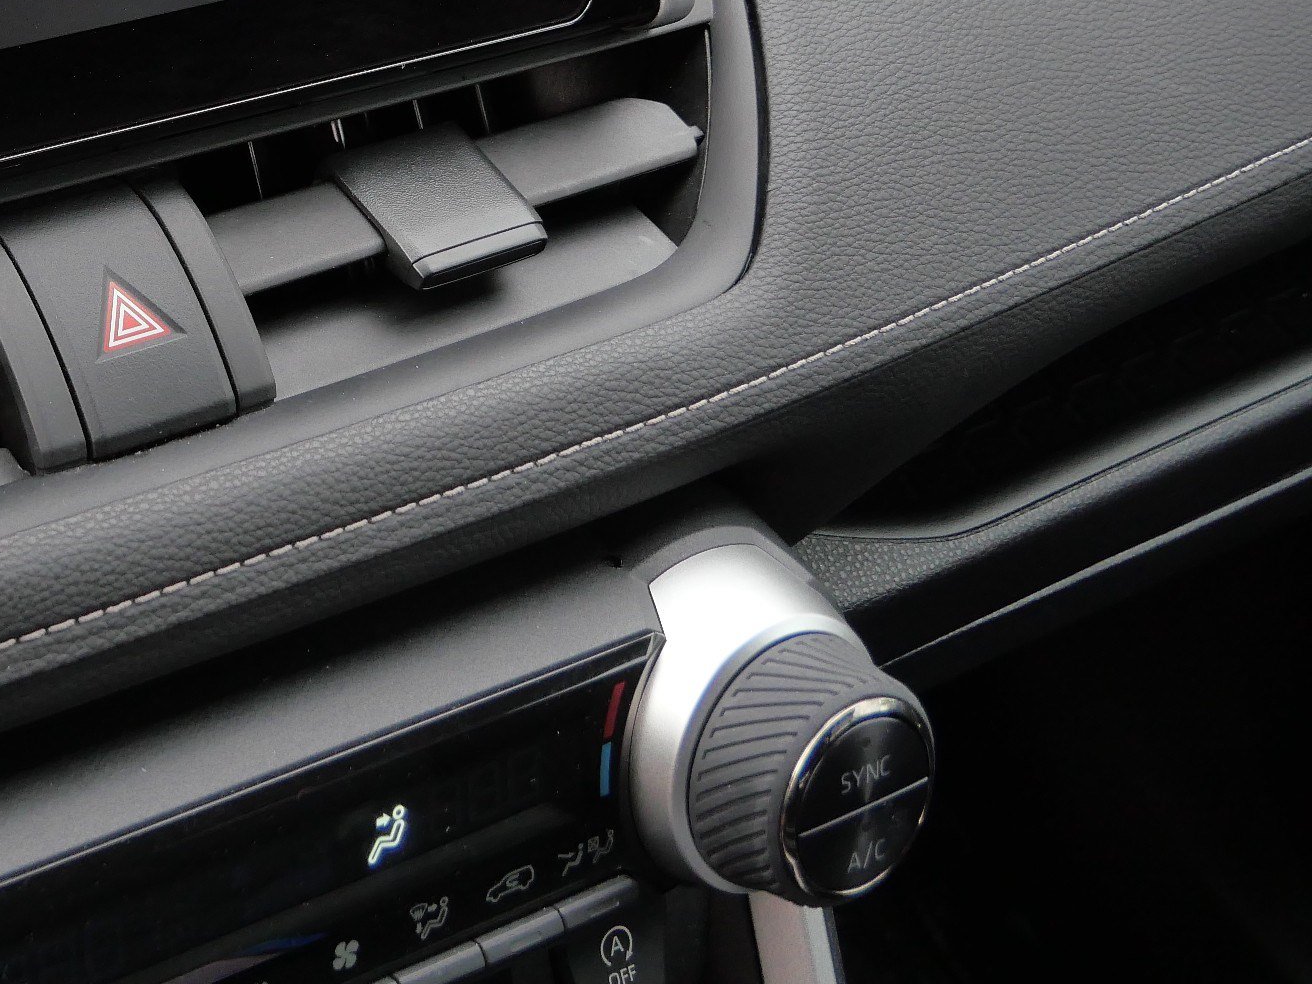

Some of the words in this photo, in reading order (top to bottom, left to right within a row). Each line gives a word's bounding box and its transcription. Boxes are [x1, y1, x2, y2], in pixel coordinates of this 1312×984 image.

[840, 754, 891, 795] SYNC
[847, 838, 886, 873] A/C
[610, 935, 625, 957] A
[608, 963, 638, 984] OFF
